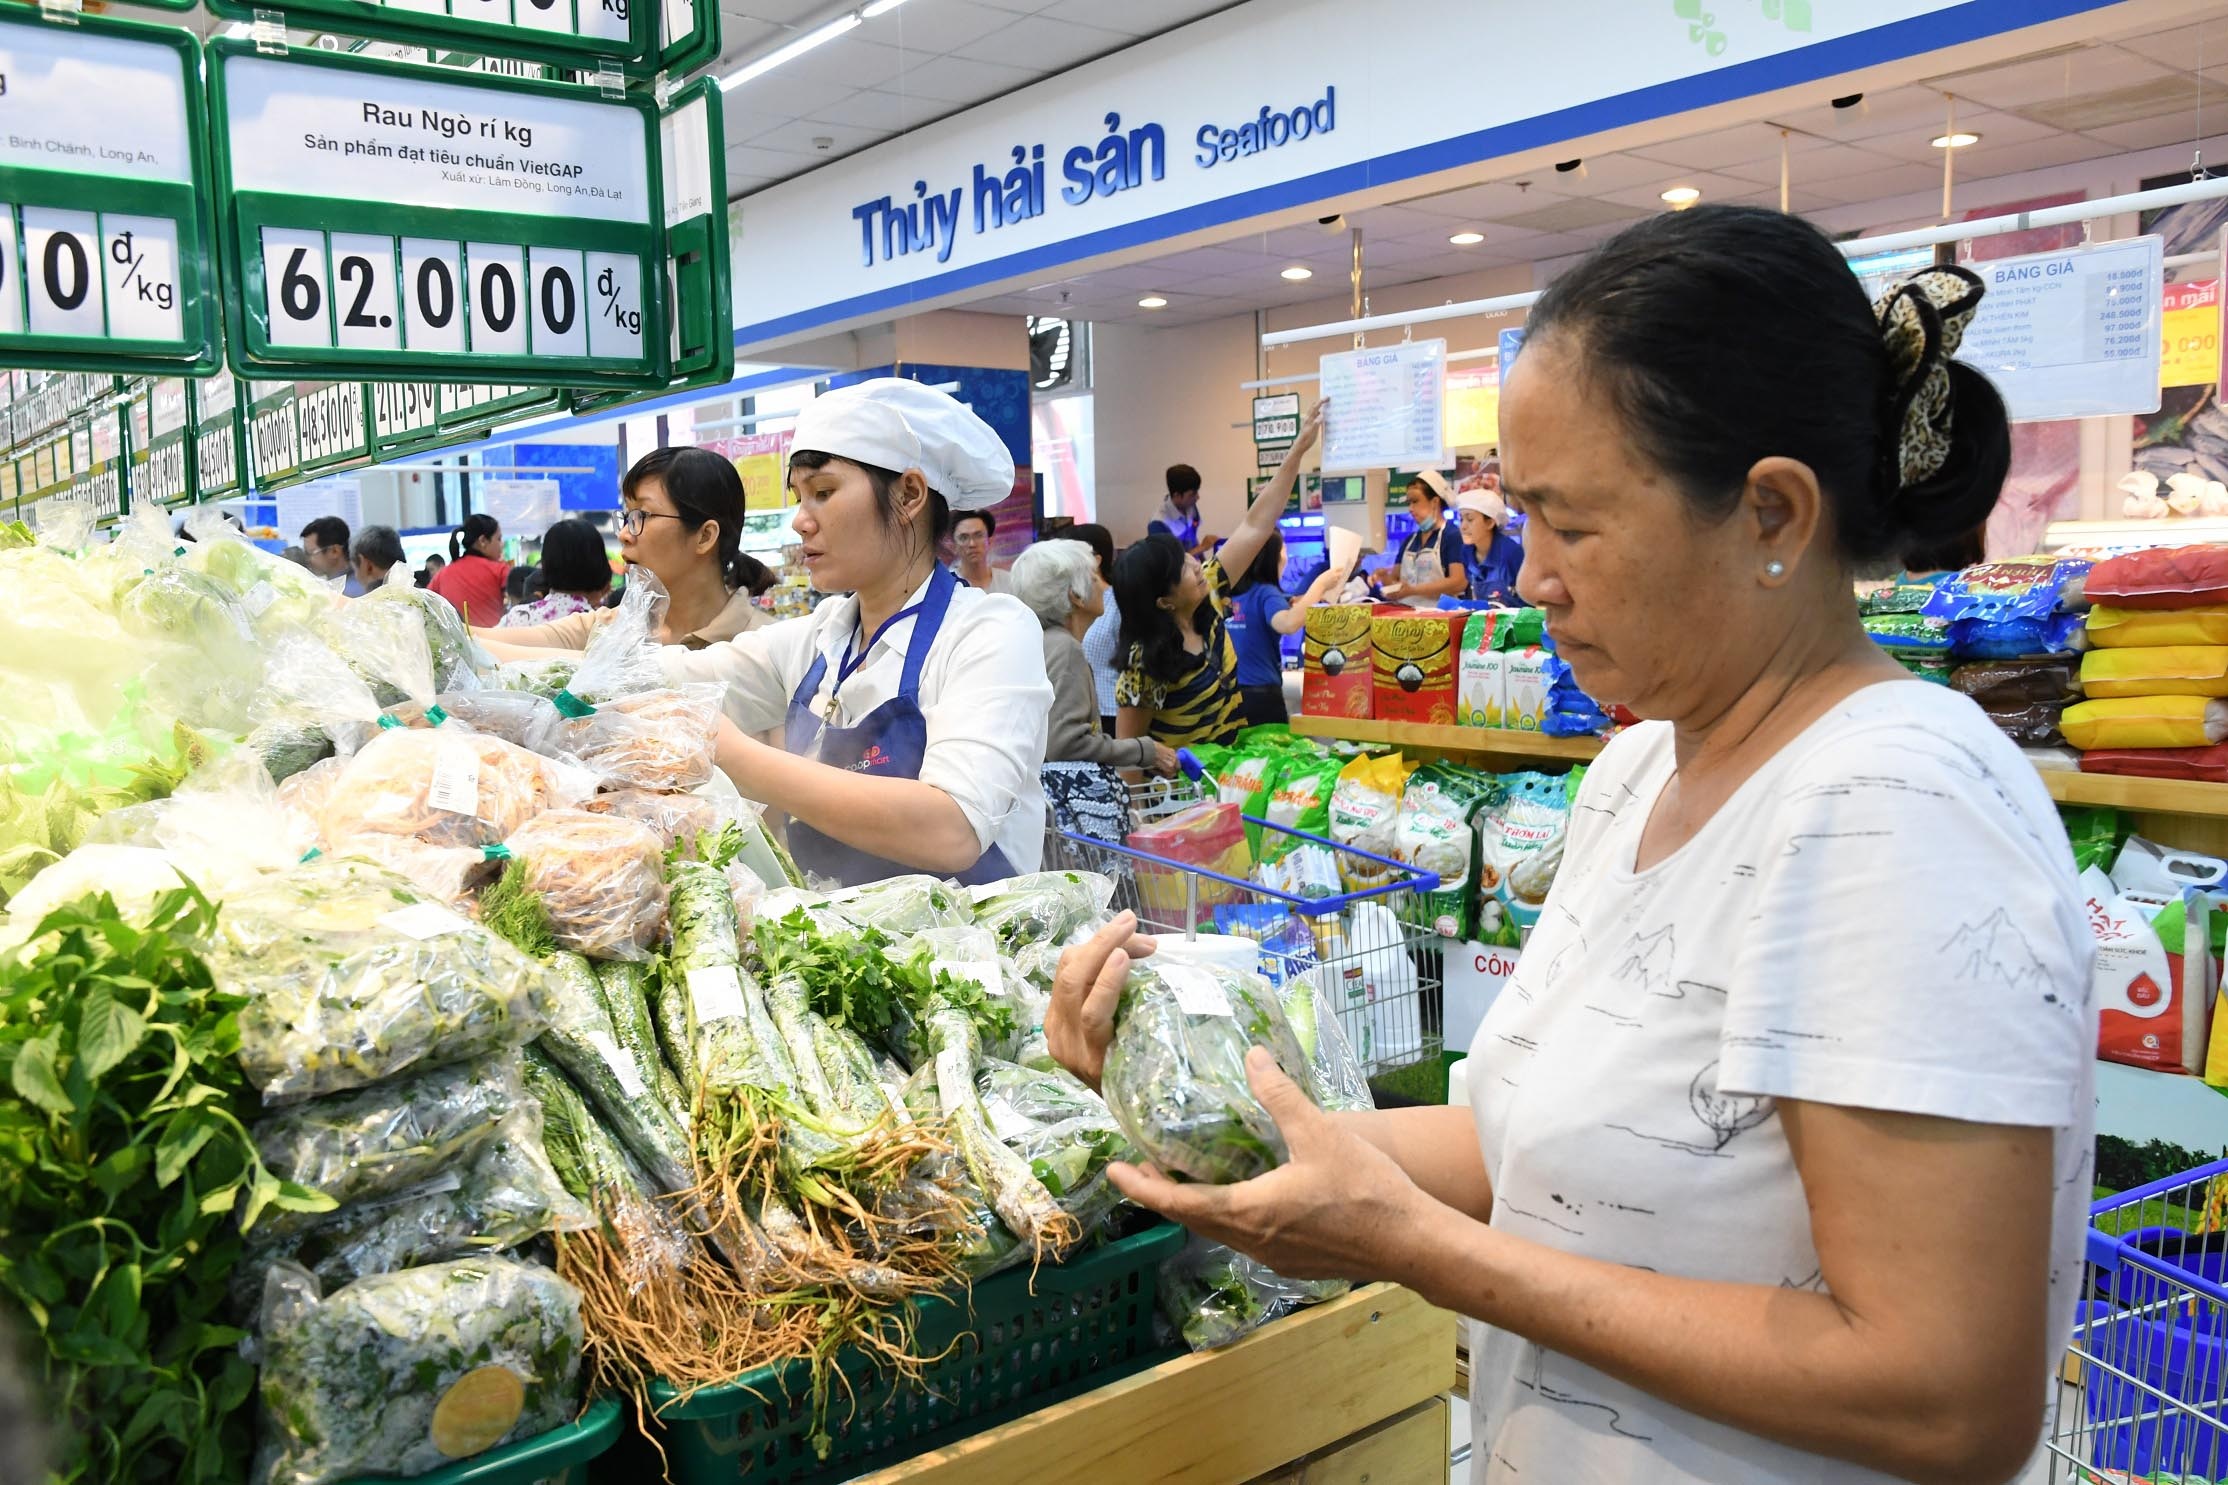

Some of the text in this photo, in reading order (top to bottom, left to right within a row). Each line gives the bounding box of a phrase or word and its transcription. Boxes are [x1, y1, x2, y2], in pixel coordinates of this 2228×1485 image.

[363, 102, 533, 147] Rau Ngò rí kg
[1195, 85, 1336, 169] Seafood
[100, 147, 134, 166] Long
[304, 133, 584, 179] Sản phẩm đạt tiêu chuẩn VietGAP
[489, 175, 512, 188] Lâm
[547, 182, 572, 197] Long
[853, 111, 1165, 267] Thủy hải sản
[112, 231, 172, 309] đ/kg
[280, 247, 642, 335] 62.000 đ/kg
